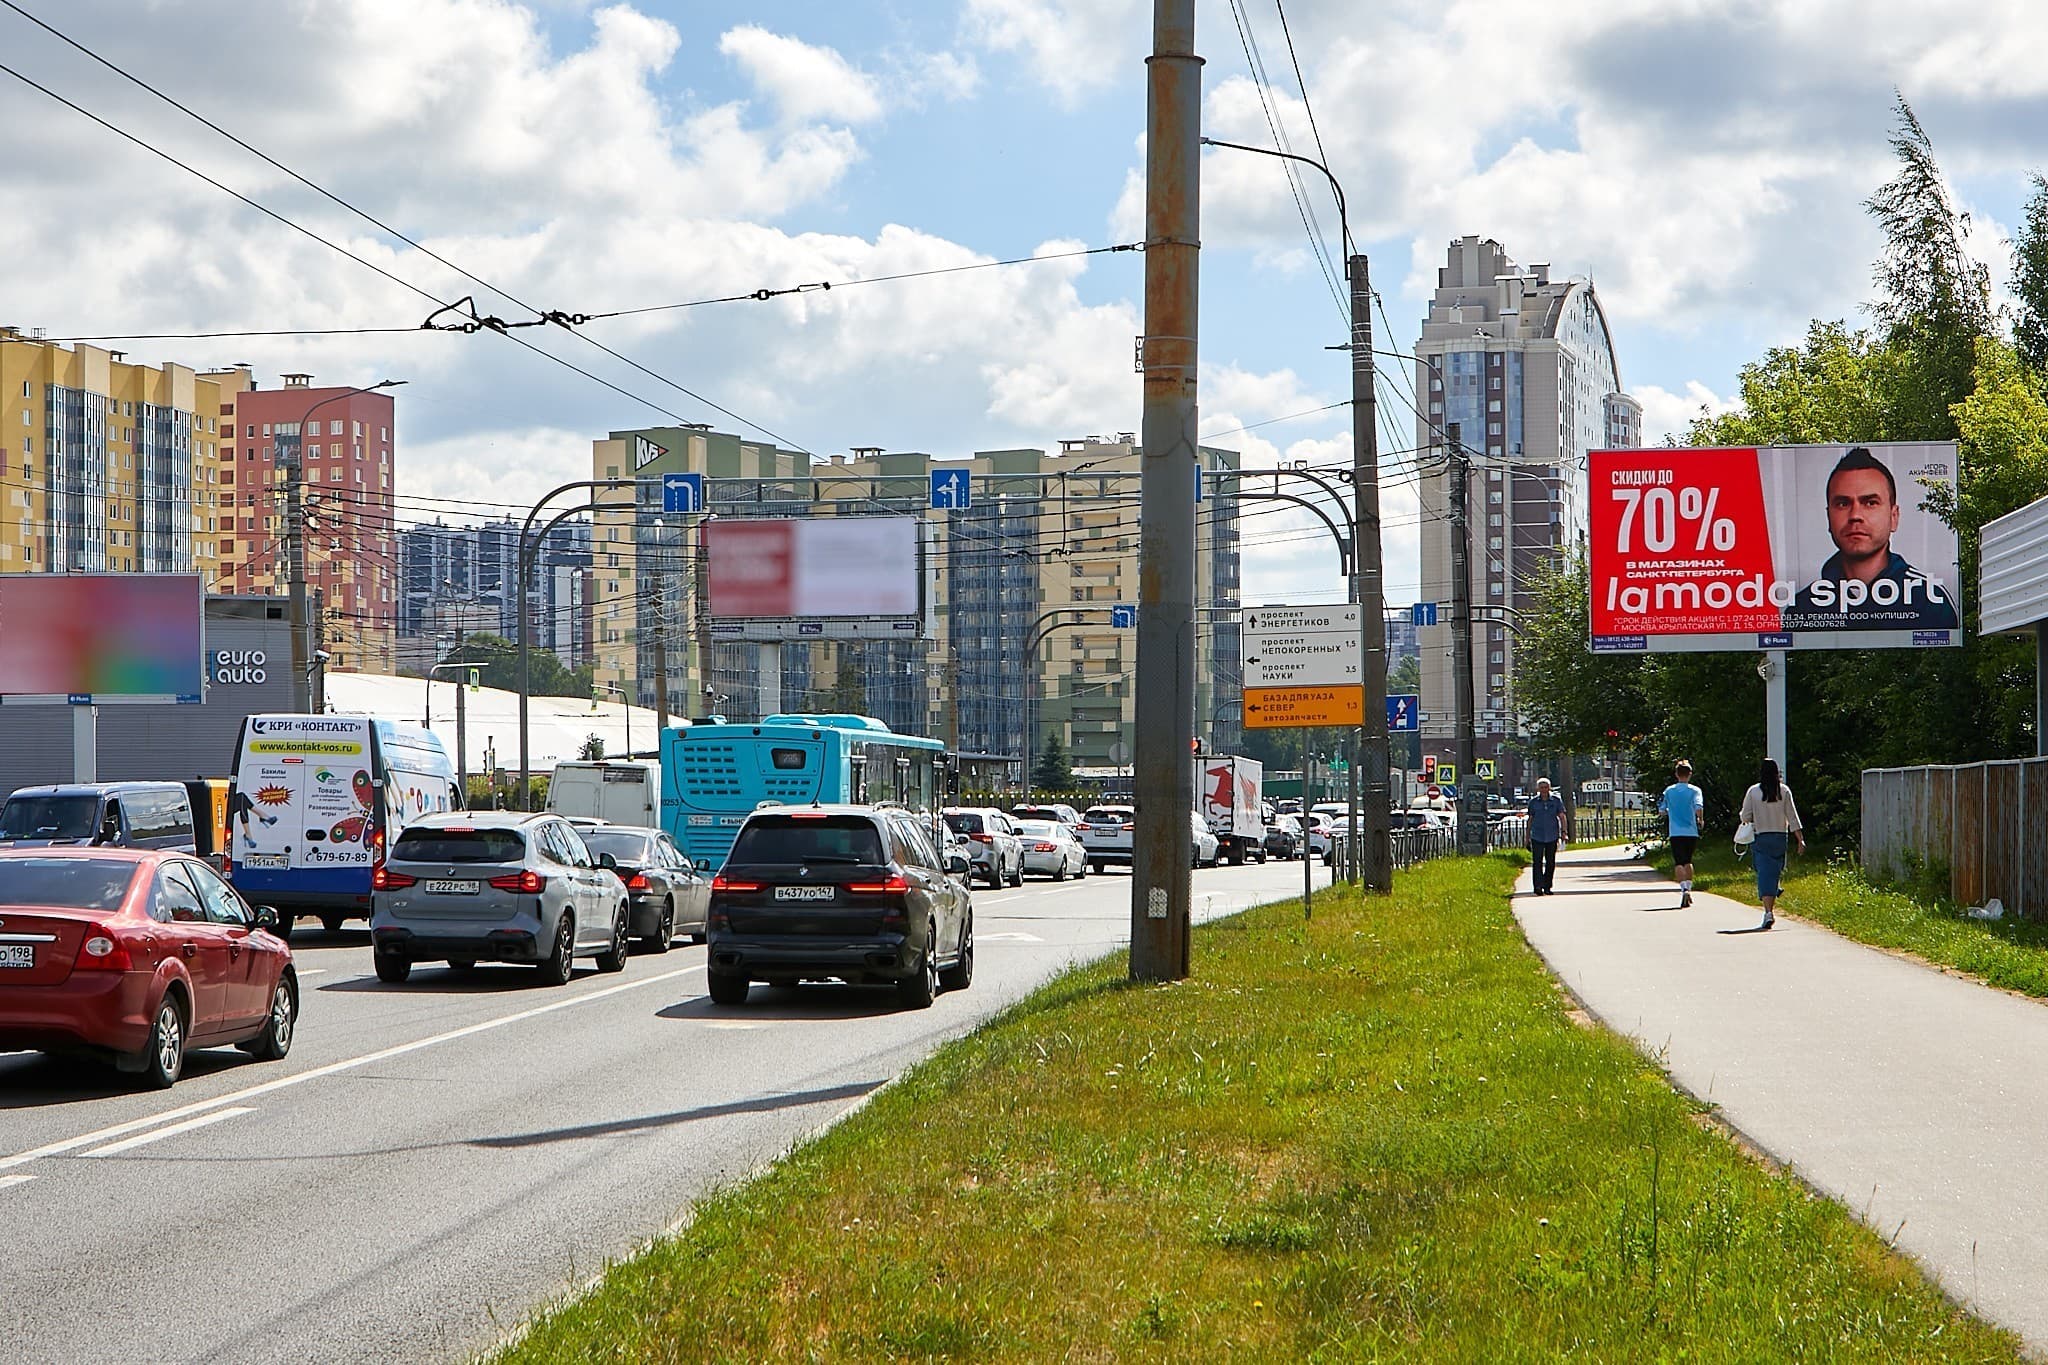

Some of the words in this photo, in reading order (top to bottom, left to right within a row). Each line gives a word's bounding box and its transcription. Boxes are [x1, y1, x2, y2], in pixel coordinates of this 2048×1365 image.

[1611, 470, 1655, 486] СКИДКИ
[1657, 469, 1673, 485] ДО
[1611, 486, 1736, 553] 70%
[1626, 561, 1637, 569] В
[1638, 559, 1725, 569] МАГАЗИНАХ
[1626, 569, 1745, 578] САНКТ-ПЕТЕРБУРГА
[1606, 573, 1796, 614] lamoda
[1810, 573, 1945, 613] sport
[1260, 610, 1304, 619] проспект
[1344, 613, 1356, 621] 4,0
[1261, 618, 1330, 628] ЭНЕРГЕТИКОВ
[1641, 615, 1687, 624] ДЕЙСТВИЯ
[1688, 615, 1718, 624] АКЦИИ
[1756, 621, 1779, 629] ОГРН
[1261, 637, 1305, 646] проспект
[1345, 640, 1356, 648] 1,5
[1262, 645, 1341, 655] НЕПОКОРЕННЫХ
[217, 650, 266, 666] euro
[1262, 663, 1305, 672] проспект
[1345, 665, 1357, 673] 3,5
[217, 665, 266, 683] auto
[1262, 672, 1293, 680] НАУКИ
[1263, 704, 1295, 712] СЕВЕР
[1263, 713, 1328, 722] автозапчасти
[269, 721, 292, 731] КРИ
[295, 721, 362, 732] «КОНТАКТ»
[259, 742, 353, 752] www.kontakt-vos.ru
[318, 787, 343, 795] Товары
[316, 852, 368, 863] 679-67-89
[429, 881, 465, 891] Е222РС
[10, 946, 30, 958] 198
